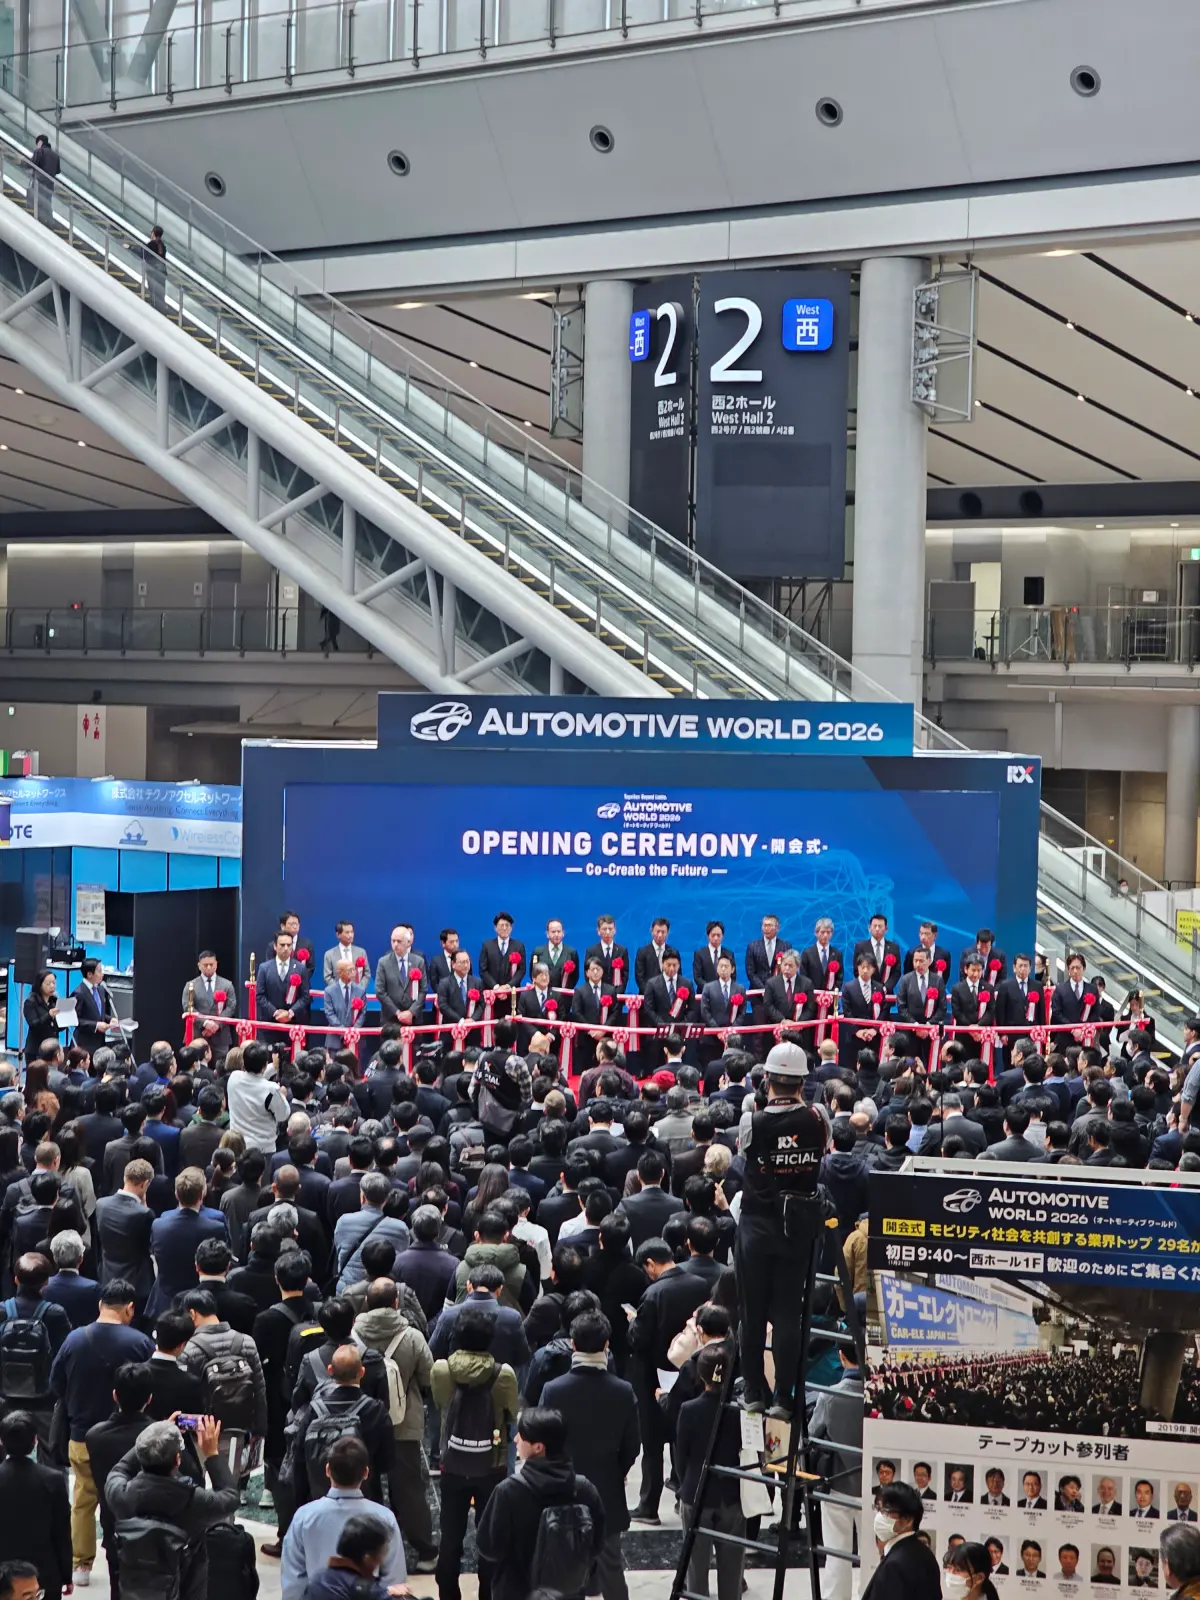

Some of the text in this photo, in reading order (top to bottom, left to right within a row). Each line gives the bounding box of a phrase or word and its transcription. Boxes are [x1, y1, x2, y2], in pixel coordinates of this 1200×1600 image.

[796, 304, 820, 316] West
[709, 297, 763, 383] 2
[796, 318, 819, 347] 西
[634, 329, 645, 357] 西
[654, 302, 677, 388] 2
[711, 394, 777, 410] 西2ホール
[711, 411, 774, 424] West Hall 2
[478, 707, 884, 741] AUTOMOTIVE WORLD 2026
[1007, 765, 1034, 783] RX
[623, 801, 693, 813] AUTOMOTIVE
[623, 812, 681, 822] WORLD 2026
[462, 830, 592, 856] OPENING
[601, 832, 758, 857] CEREMONY
[585, 862, 708, 877] Co-Create the Future
[778, 1135, 798, 1149] RX
[988, 1187, 1109, 1210] AUTOMOTIVE
[988, 1207, 1047, 1222] WORLD
[1051, 1212, 1089, 1225] 2026
[885, 1220, 922, 1235] 開会式
[929, 1223, 1153, 1250] モビリティ社会を共創する業界トップ
[971, 1253, 1042, 1269] 西ホール1F
[1157, 1424, 1187, 1433] 2019年
[978, 1434, 1130, 1461] テープカット参列者
